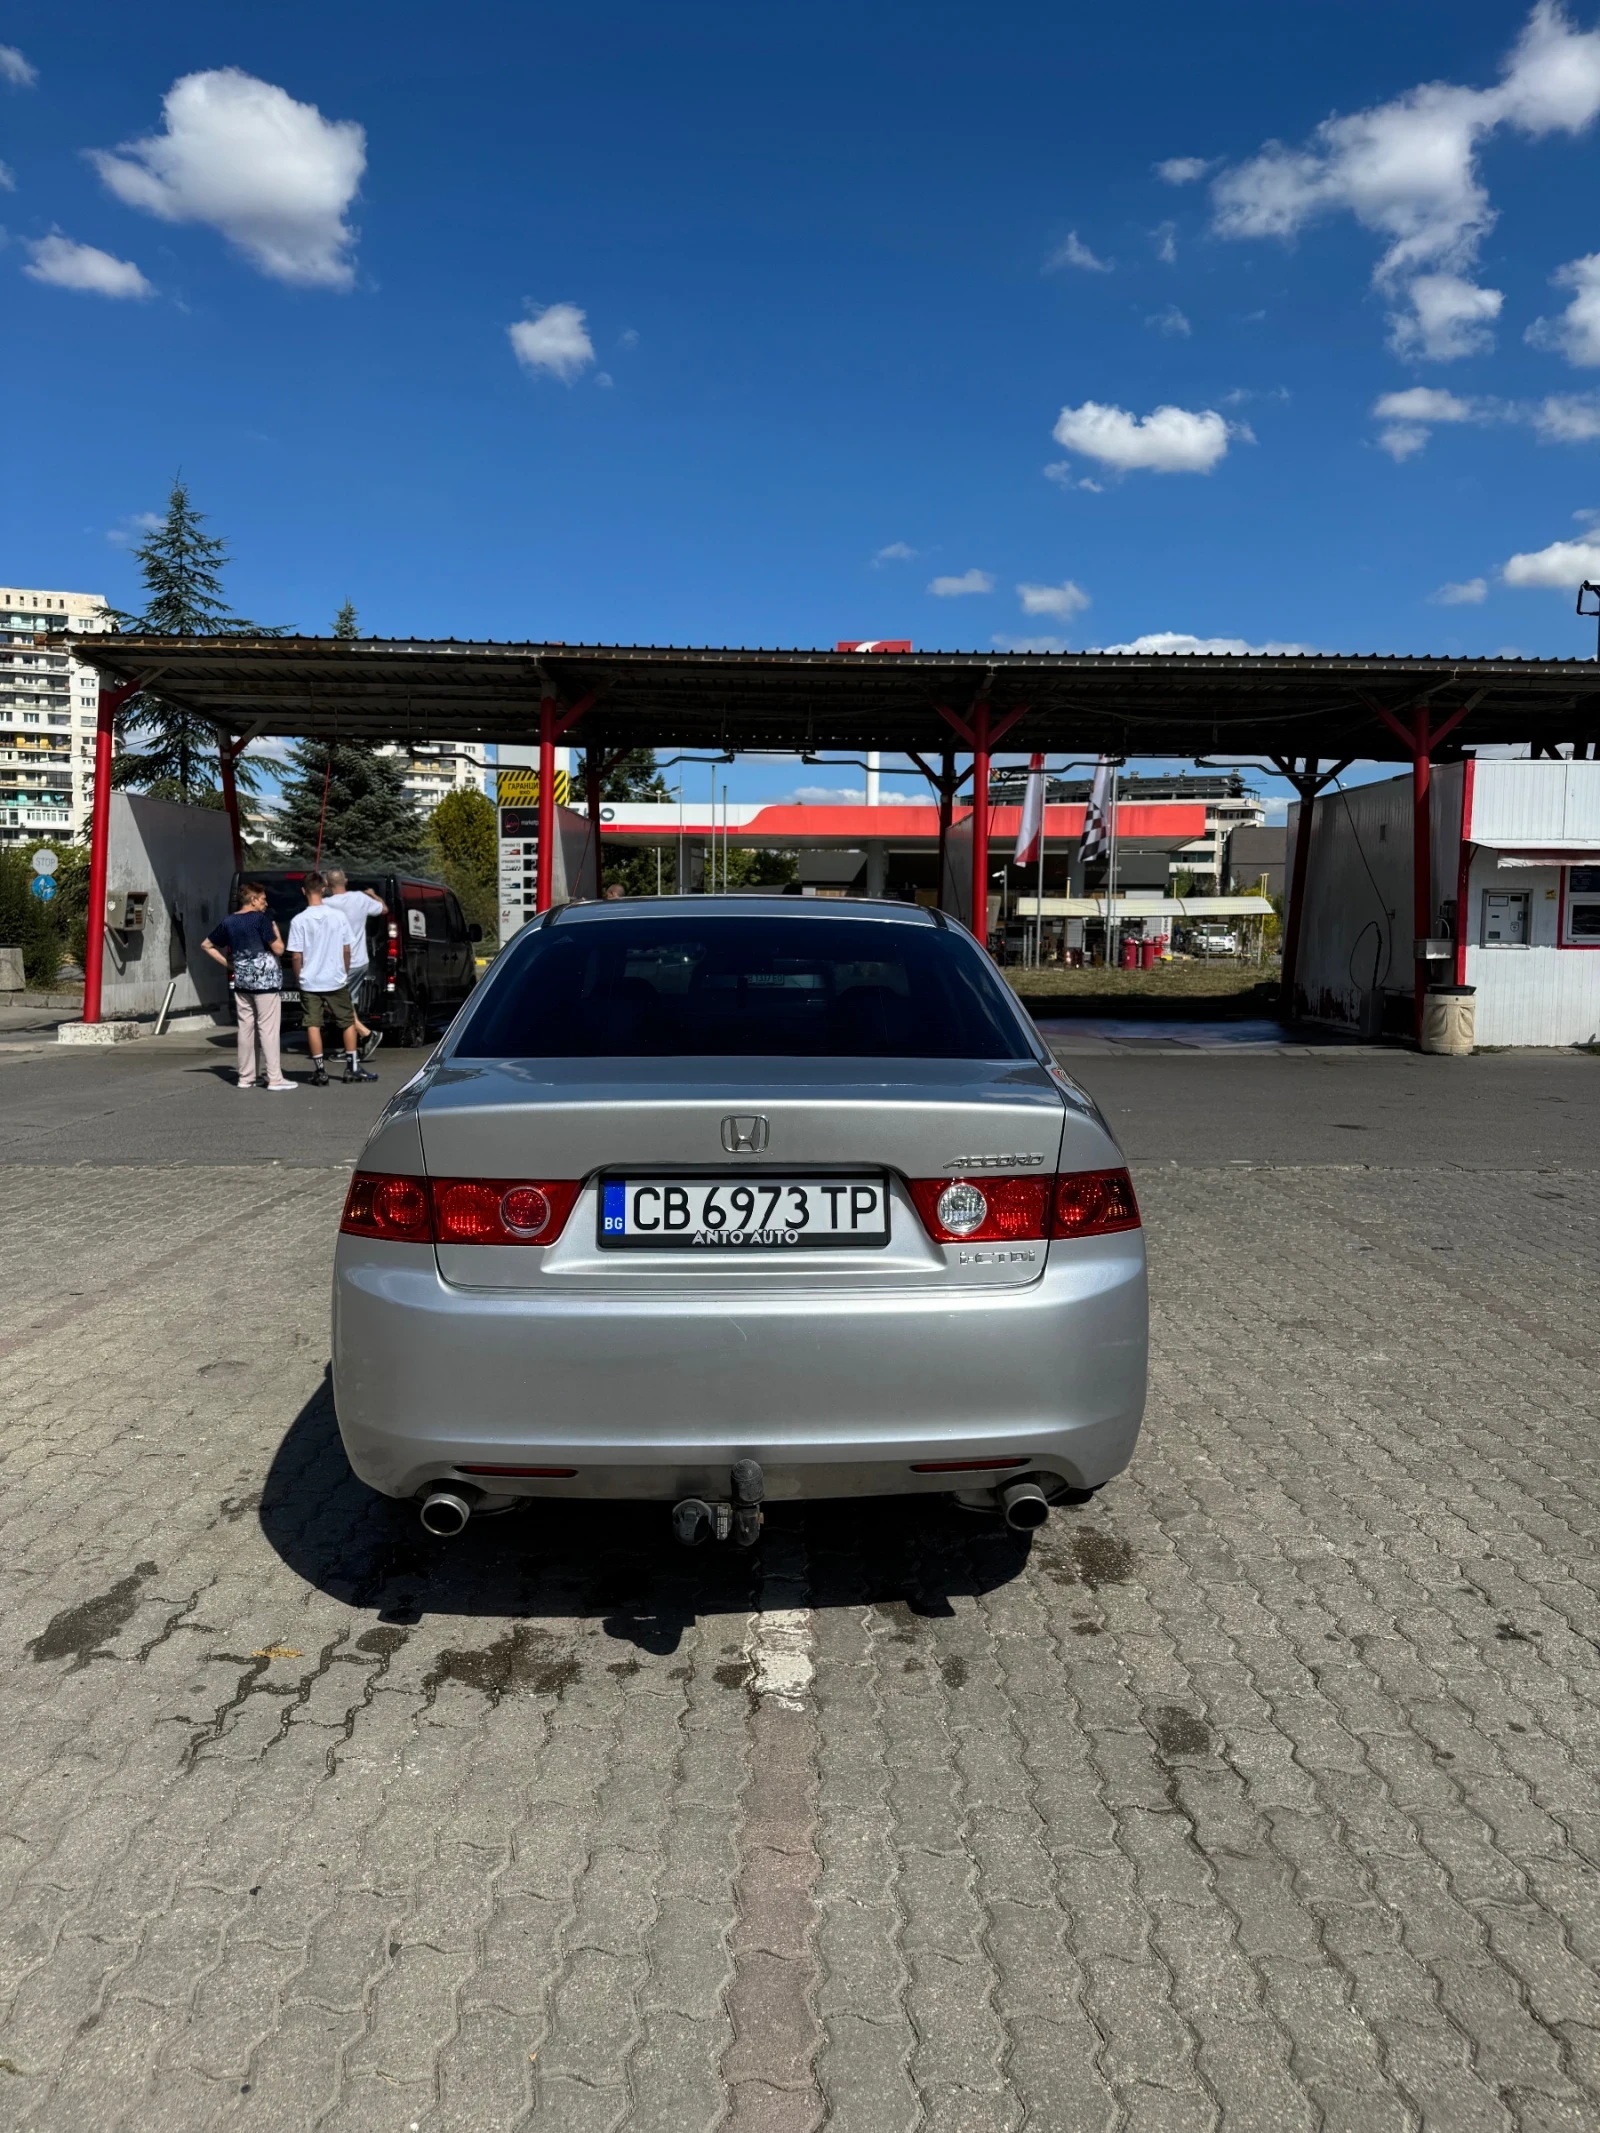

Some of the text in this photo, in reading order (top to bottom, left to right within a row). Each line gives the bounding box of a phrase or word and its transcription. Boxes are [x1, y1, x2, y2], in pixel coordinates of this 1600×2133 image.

[508, 782, 539, 790] ГАРАНЦИ
[35, 857, 56, 867] STOP
[942, 1153, 1045, 1169] ACCORD
[633, 1186, 877, 1231] CB 6973 TP
[604, 1217, 623, 1230] BG
[691, 1228, 799, 1245] ANTO AUTO
